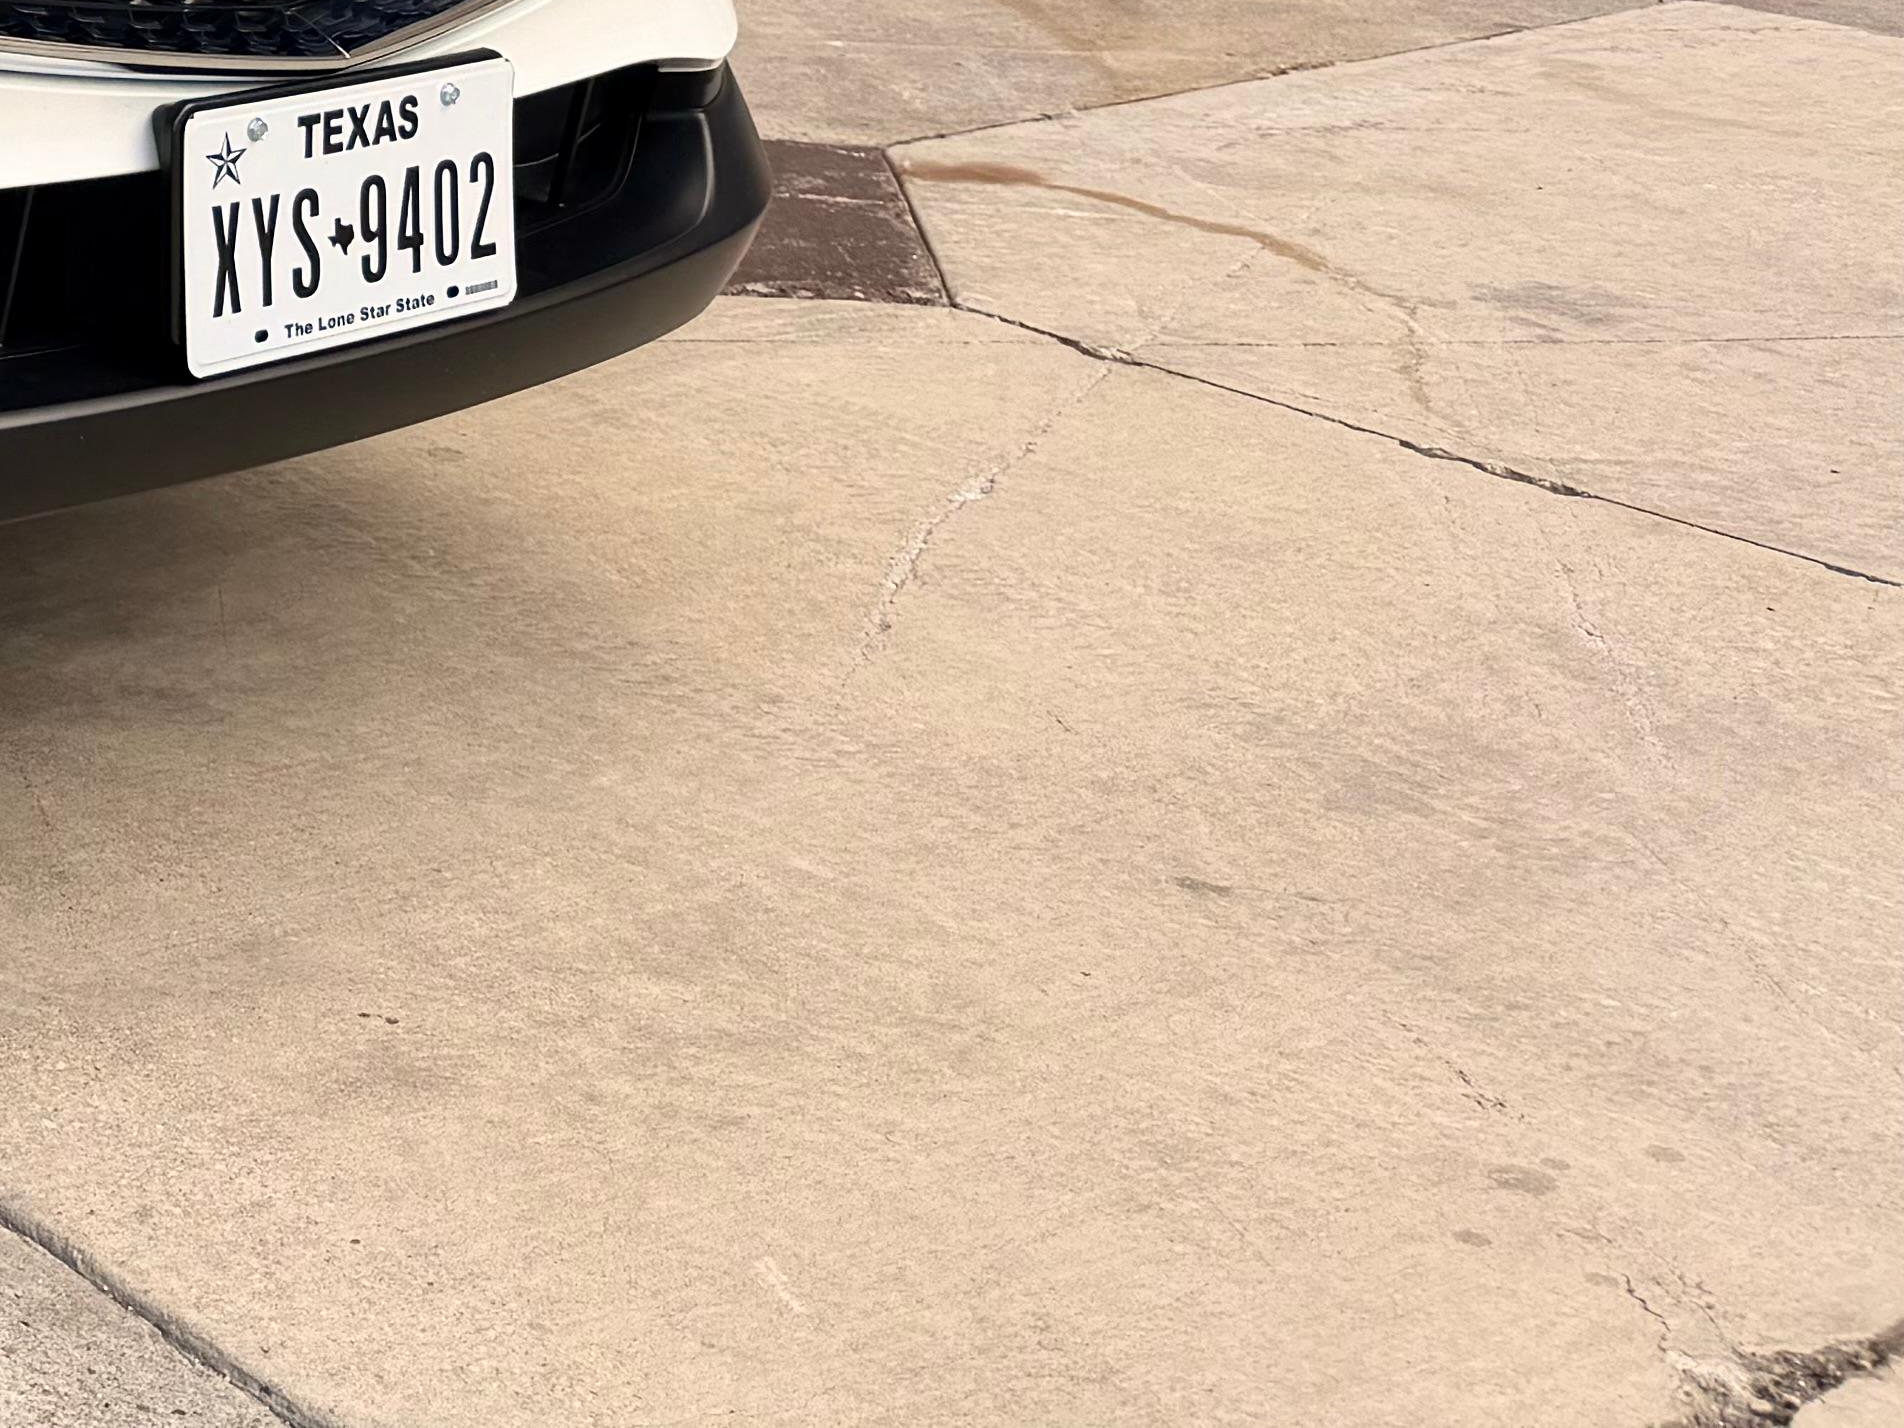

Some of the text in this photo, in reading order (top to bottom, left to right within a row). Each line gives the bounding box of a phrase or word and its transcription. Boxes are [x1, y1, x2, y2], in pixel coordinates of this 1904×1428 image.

[297, 95, 419, 158] TEXAS
[284, 294, 435, 339] The Lone Star State
